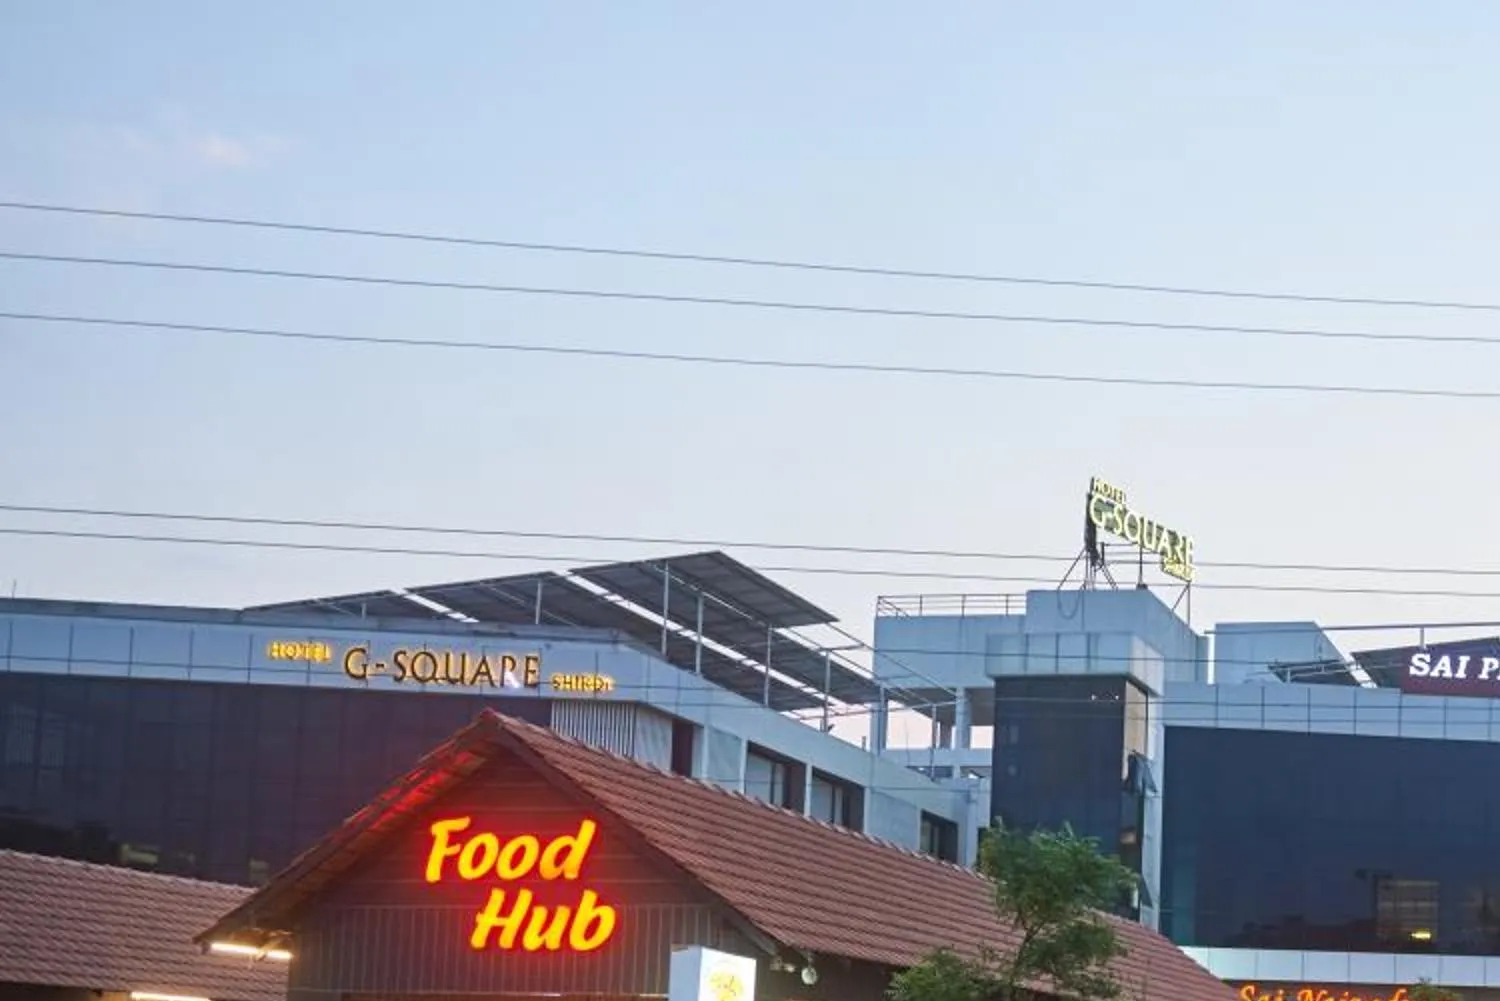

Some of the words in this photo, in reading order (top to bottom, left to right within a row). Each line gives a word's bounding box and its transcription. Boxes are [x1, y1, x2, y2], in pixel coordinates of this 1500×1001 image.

[1409, 653, 1471, 679] SAI
[425, 816, 597, 884] Food
[470, 888, 616, 950] Hub
